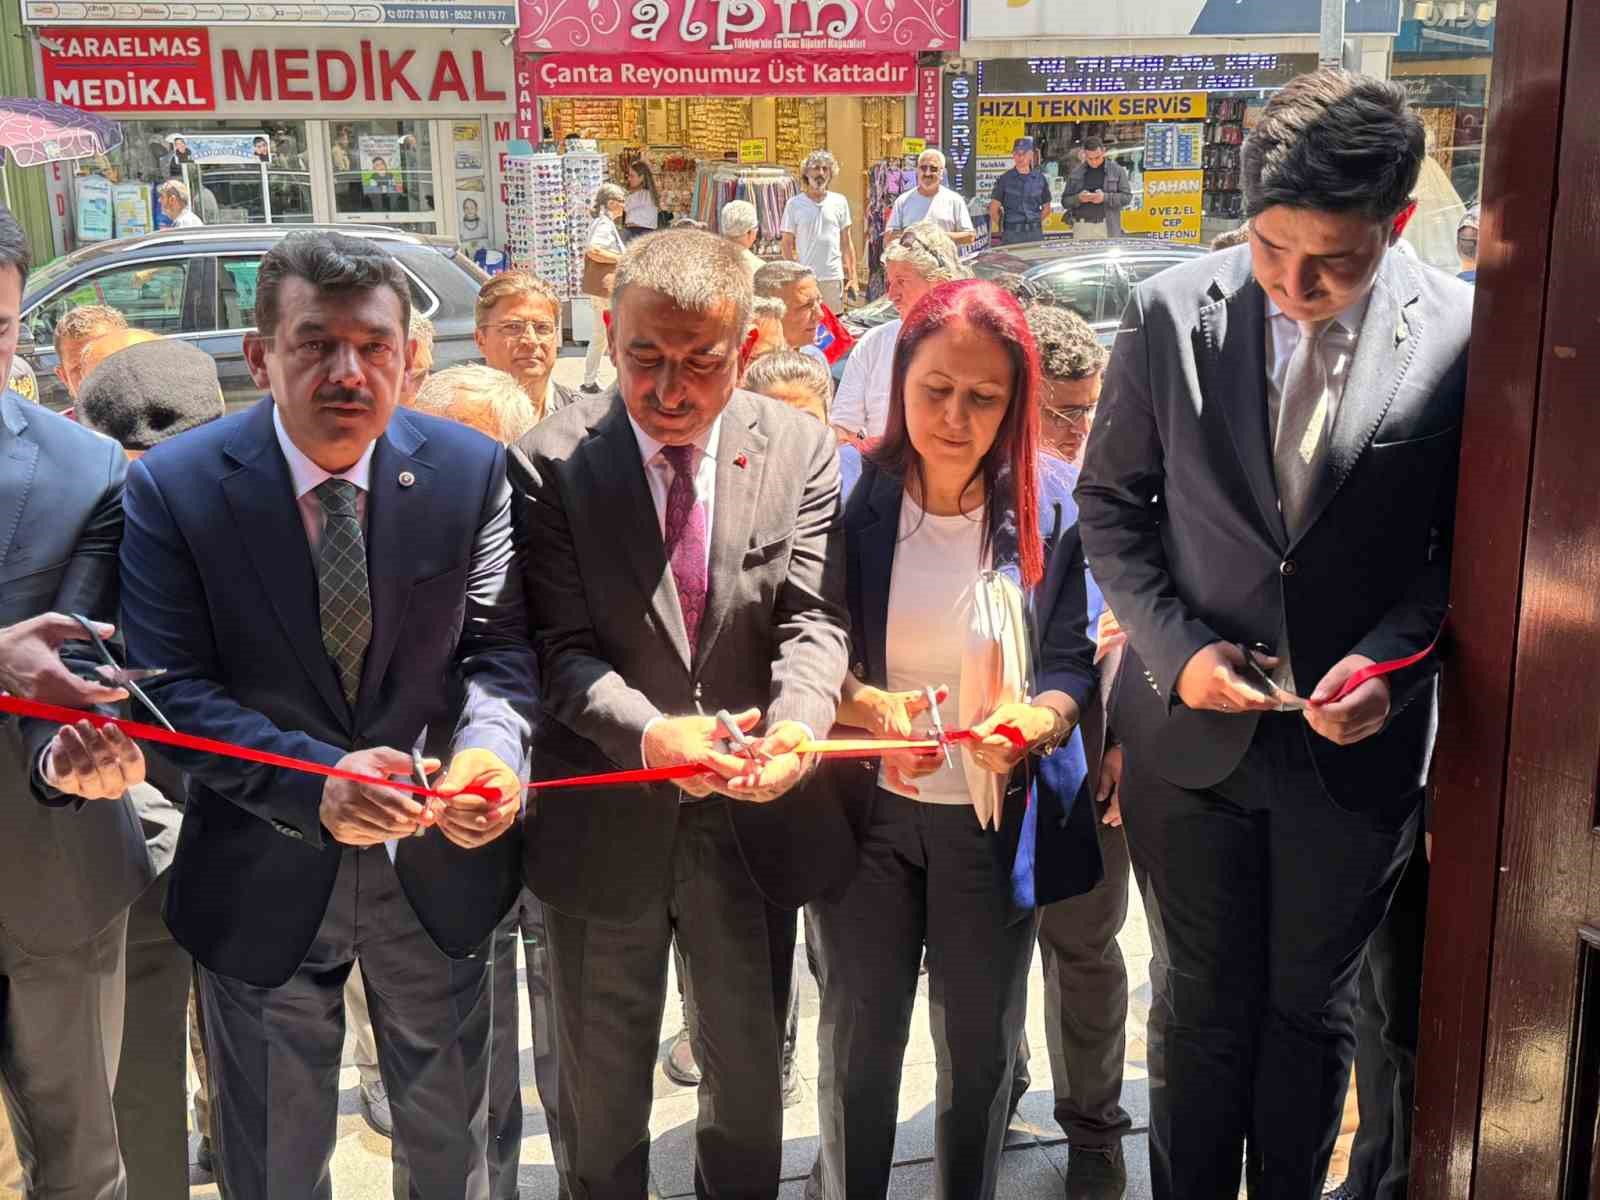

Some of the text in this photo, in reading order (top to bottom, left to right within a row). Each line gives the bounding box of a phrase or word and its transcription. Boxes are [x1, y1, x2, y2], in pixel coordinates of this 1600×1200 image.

[48, 36, 202, 57] KARAELMAS
[220, 40, 506, 102] MEDİKAL
[541, 60, 909, 89] Çanta Reyonumuz Üst Kattadır
[52, 71, 207, 107] MEDİKAL
[517, 71, 533, 139] ÇANT
[979, 101, 1033, 118] HIZLI
[1148, 180, 1201, 197] ŞAHAN
[1158, 206, 1172, 216] VE
[1184, 206, 1196, 215] EL
[1162, 218, 1183, 228] CEP
